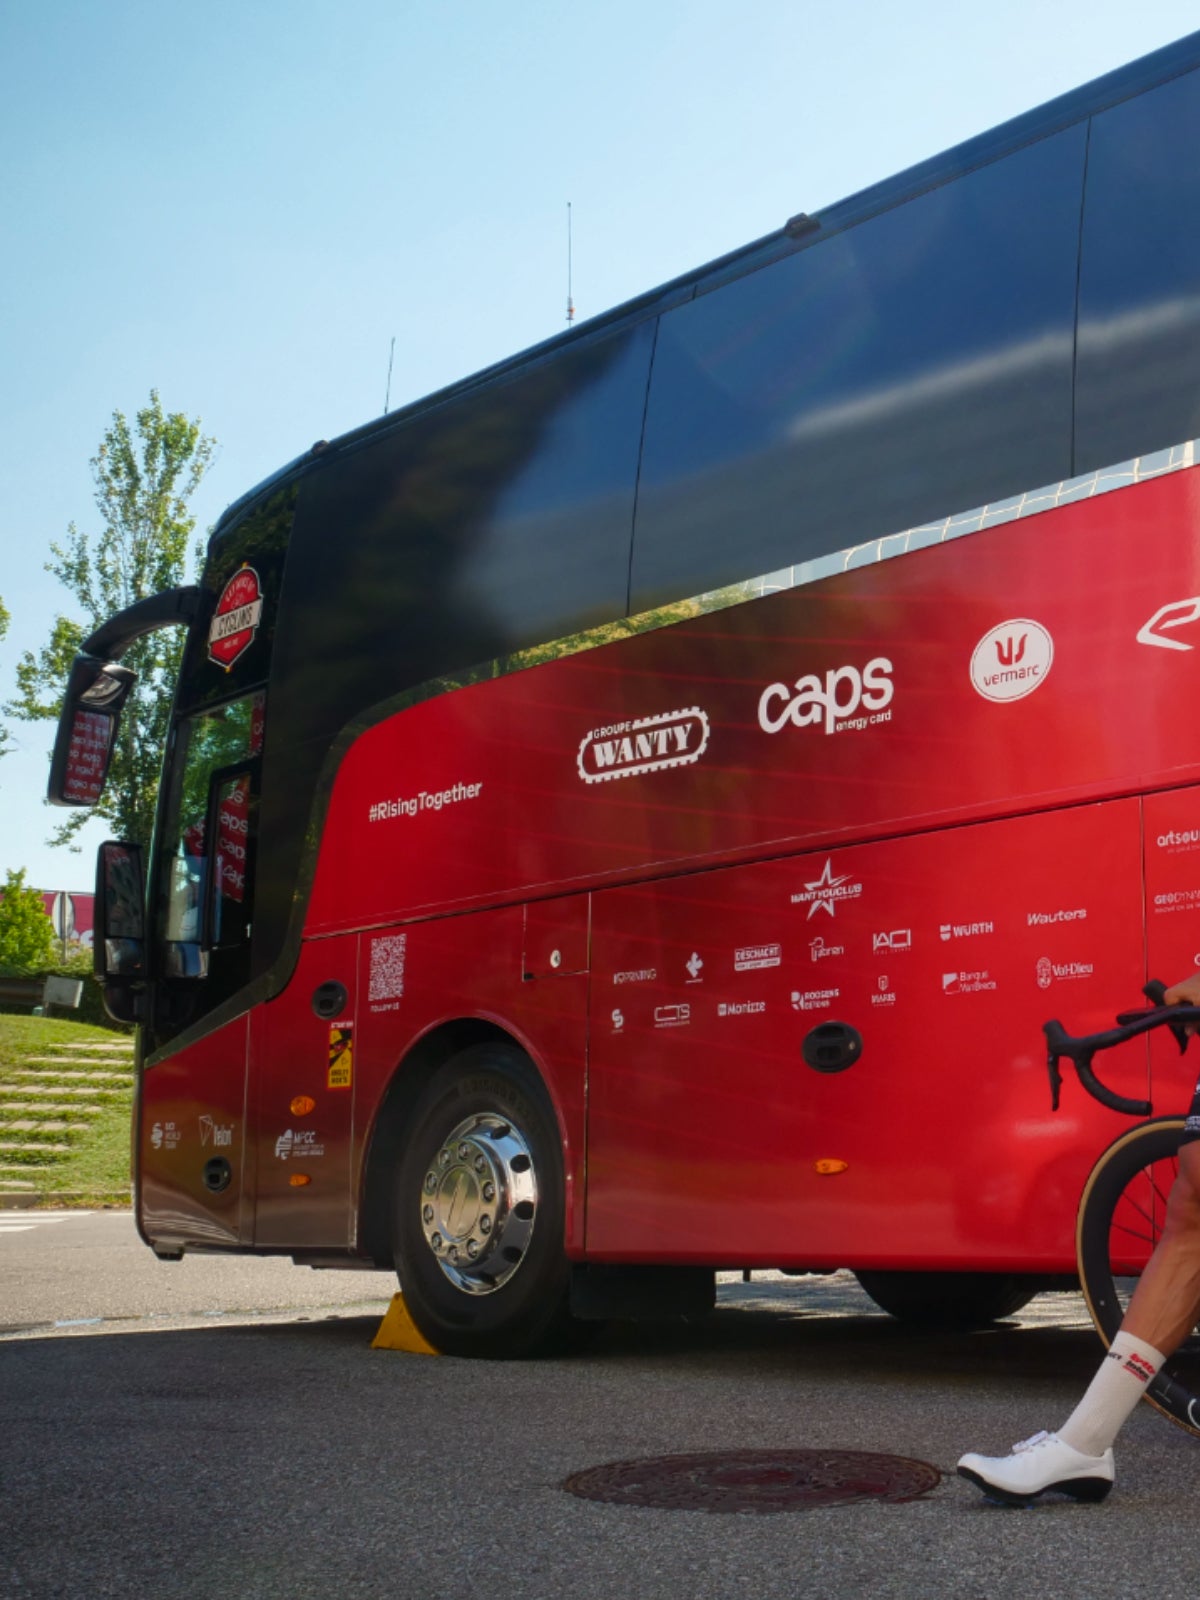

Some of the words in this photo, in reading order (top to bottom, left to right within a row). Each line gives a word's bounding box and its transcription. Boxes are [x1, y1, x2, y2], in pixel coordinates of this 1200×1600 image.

[983, 663, 1040, 687] vermarc
[757, 656, 895, 735] caps
[869, 709, 892, 724] card
[593, 720, 632, 740] GROUPE
[592, 722, 694, 769] WANTY
[368, 780, 483, 823] #RisingTogether
[1026, 908, 1087, 926] Wauters
